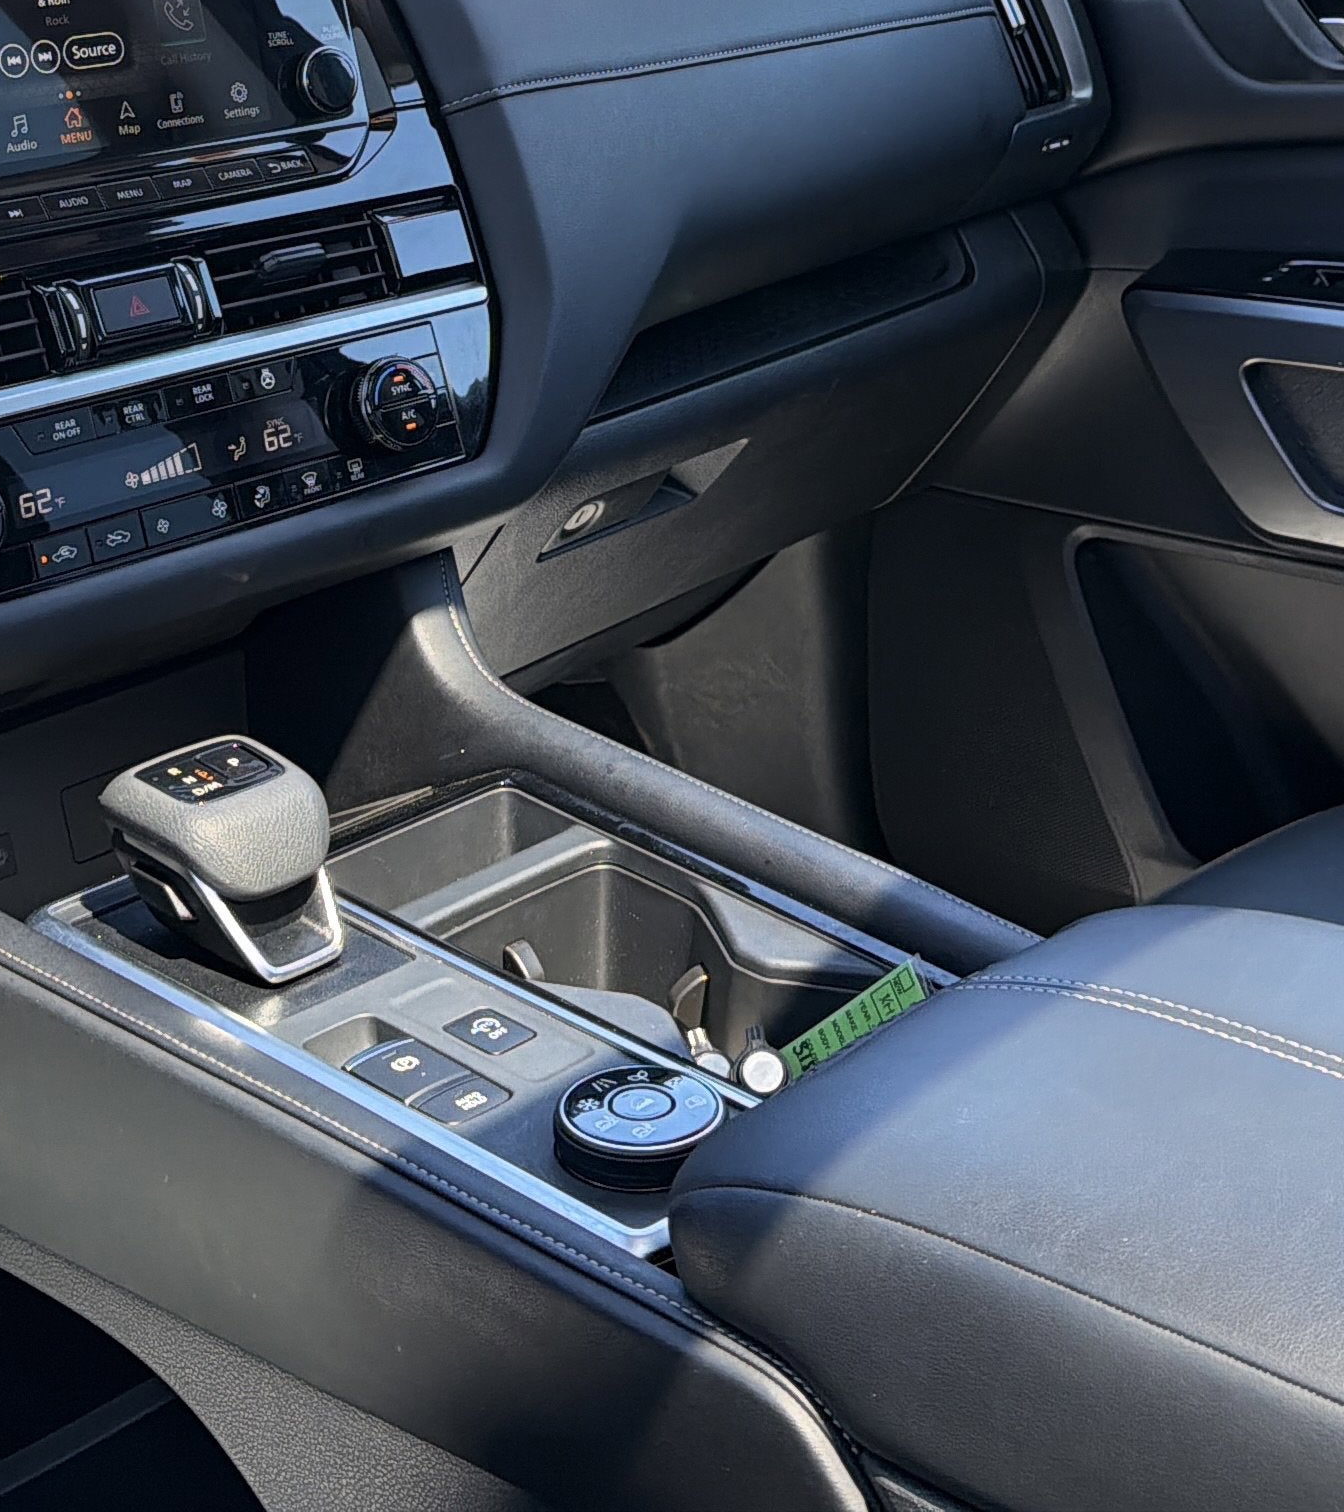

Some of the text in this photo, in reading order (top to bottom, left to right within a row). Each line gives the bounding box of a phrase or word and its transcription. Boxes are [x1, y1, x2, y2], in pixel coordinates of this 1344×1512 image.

[45, 13, 70, 26] Rock
[268, 37, 295, 48] SCROLL
[71, 43, 117, 60] Source
[160, 51, 212, 66] Call History
[224, 105, 261, 121] Settings
[157, 114, 205, 130] Connections
[60, 129, 93, 145] MENU
[118, 123, 141, 138] Map
[6, 139, 38, 154] Audio
[279, 159, 305, 171] BACK
[217, 167, 254, 181] CAMERA
[172, 177, 193, 189] MAP
[116, 188, 144, 200] MENU
[59, 195, 89, 209] AUDIO
[390, 383, 413, 396] SYNC
[194, 392, 215, 404] LOCK
[122, 402, 145, 415] REAR
[401, 409, 417, 421] A/C
[54, 418, 77, 430] REAR
[125, 412, 146, 424] CTRL
[265, 416, 285, 428] SYNC
[262, 423, 294, 452] 62
[18, 488, 53, 519] 62
[227, 756, 240, 767] P
[859, 999, 872, 1022] YEAR
[845, 1009, 858, 1033] MAKE
[817, 1027, 831, 1050] BODY
[830, 1018, 847, 1047] MODEL
